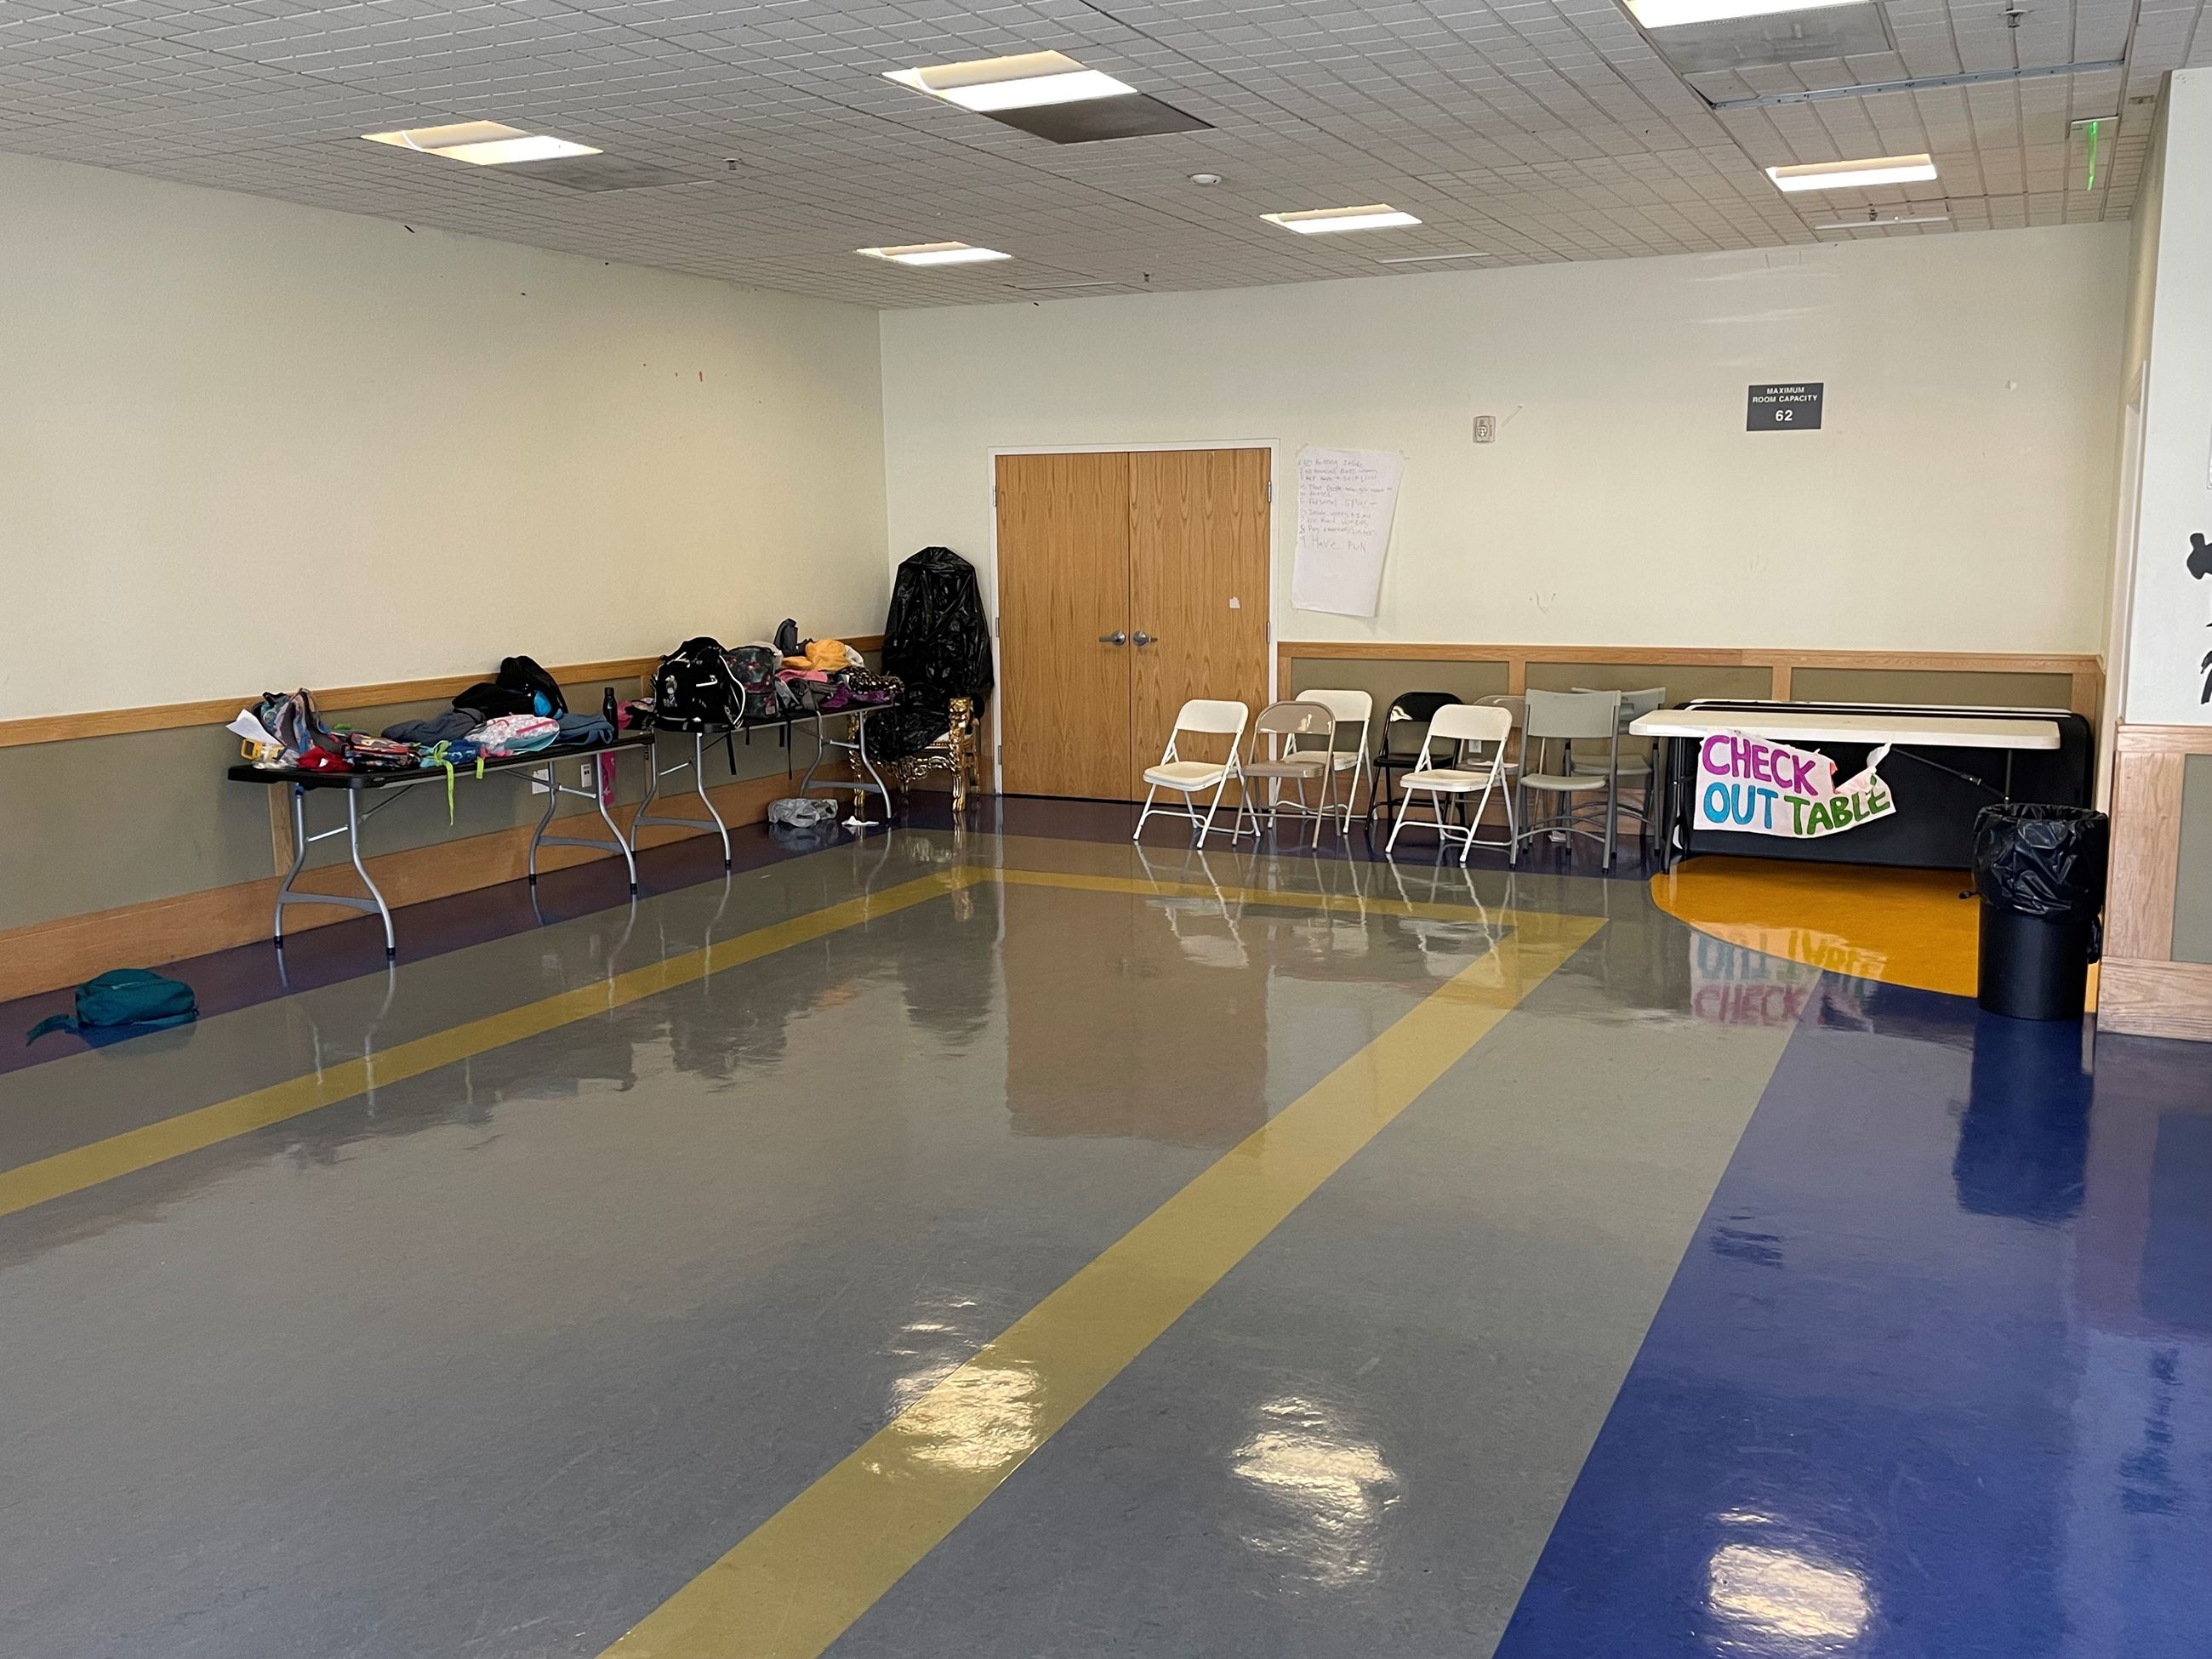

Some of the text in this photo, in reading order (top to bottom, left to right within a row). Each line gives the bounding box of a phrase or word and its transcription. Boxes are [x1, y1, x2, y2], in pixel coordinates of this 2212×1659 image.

[1775, 409, 1793, 422] 62
[1778, 394, 1818, 402] CAPACITY
[1702, 735, 1819, 796] CHECK
[1703, 775, 1890, 835] OUT TABLE
